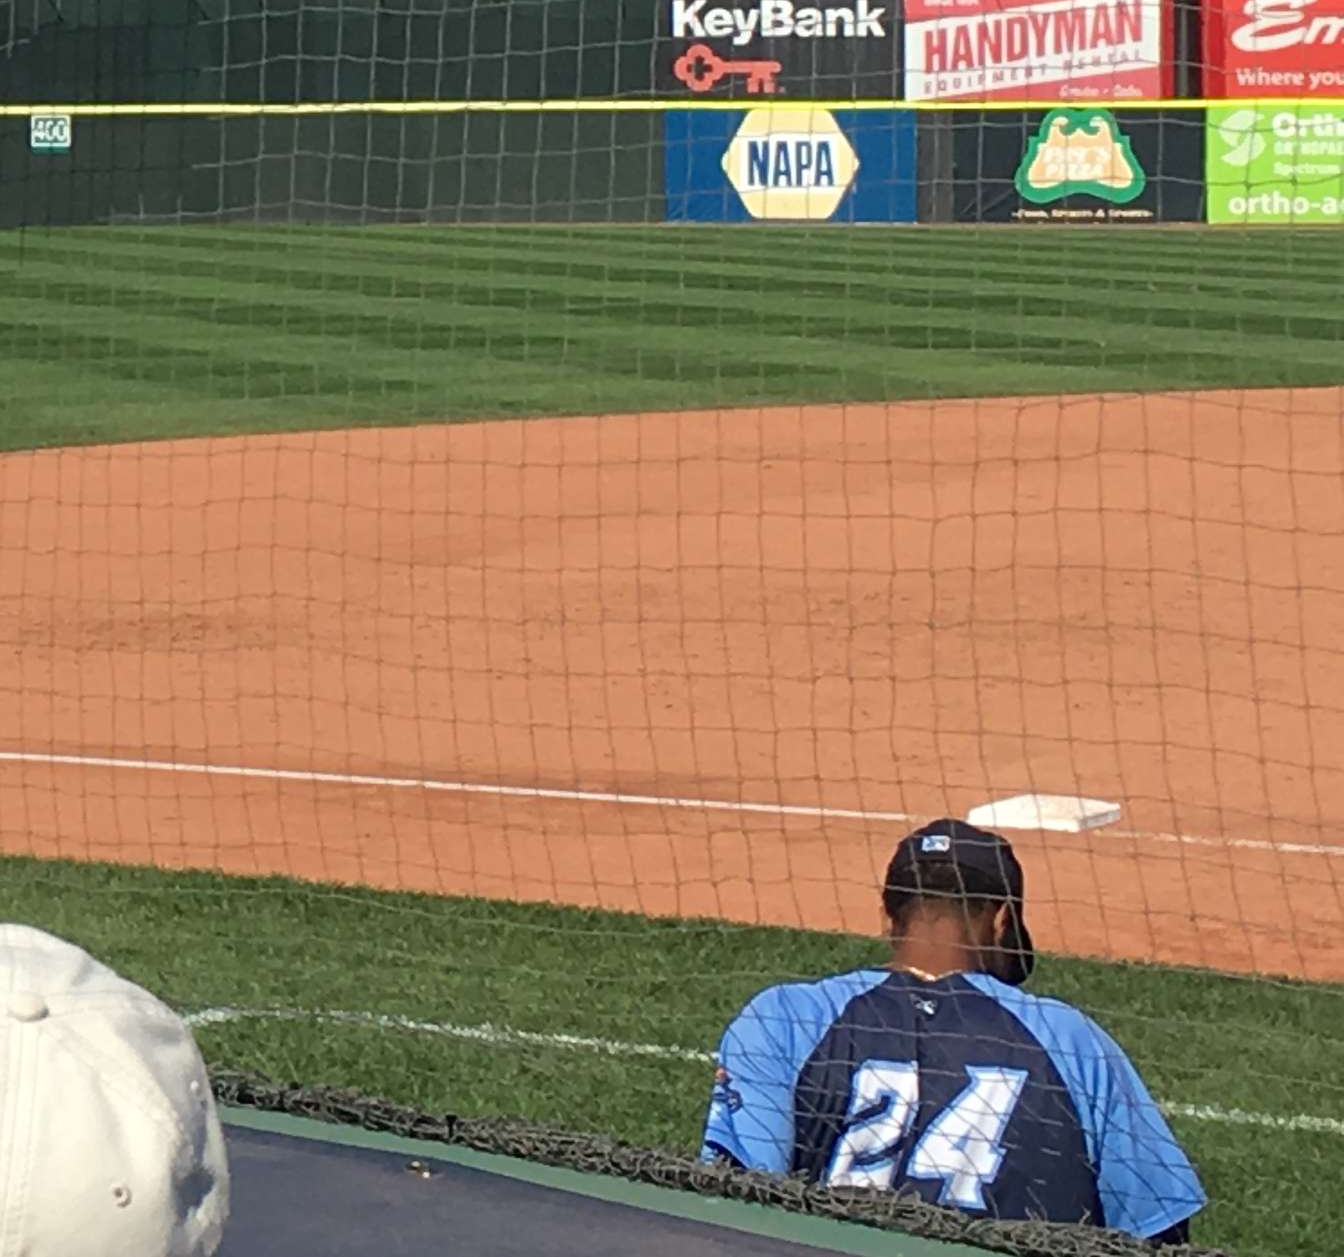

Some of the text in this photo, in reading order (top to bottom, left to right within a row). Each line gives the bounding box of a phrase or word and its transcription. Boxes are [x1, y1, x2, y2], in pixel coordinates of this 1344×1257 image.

[924, 62, 1050, 94] EQUIPMENT
[1235, 68, 1305, 87] Where
[747, 140, 835, 187] NAPA
[1227, 190, 1344, 215] ortho-a
[819, 1058, 1030, 1211] 24
